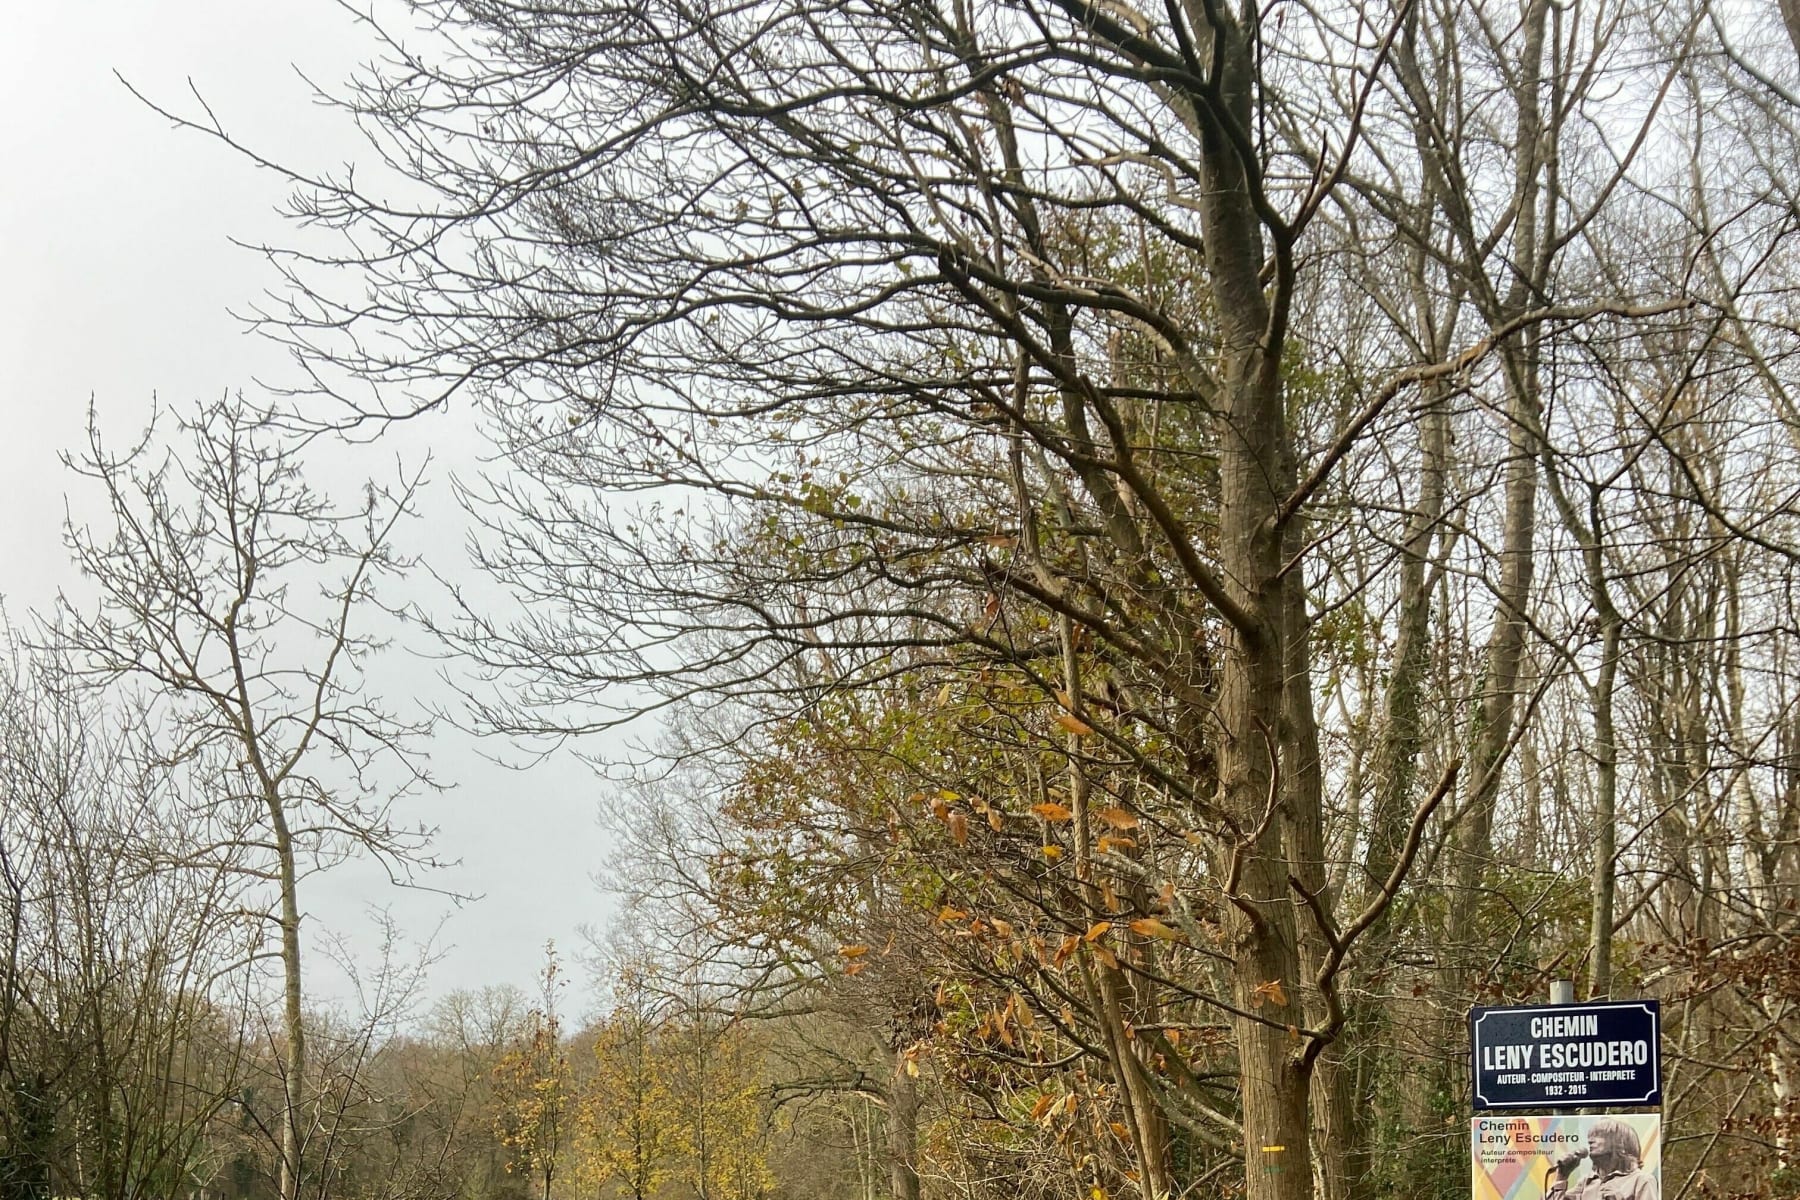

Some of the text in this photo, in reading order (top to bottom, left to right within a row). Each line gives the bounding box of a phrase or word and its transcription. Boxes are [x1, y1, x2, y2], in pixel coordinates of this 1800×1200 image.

[1530, 1015, 1598, 1038] CHEMIN
[1484, 1040, 1648, 1071] LENY ESCUDERO
[1496, 1073, 1526, 1085] AUTEUR
[1531, 1071, 1584, 1083] COMPOSITEUR
[1568, 1084, 1587, 1095] 2015
[1479, 1120, 1529, 1131] Chemin
[1479, 1132, 1579, 1145] Leny Escudero
[1507, 1149, 1554, 1157] compositeur
